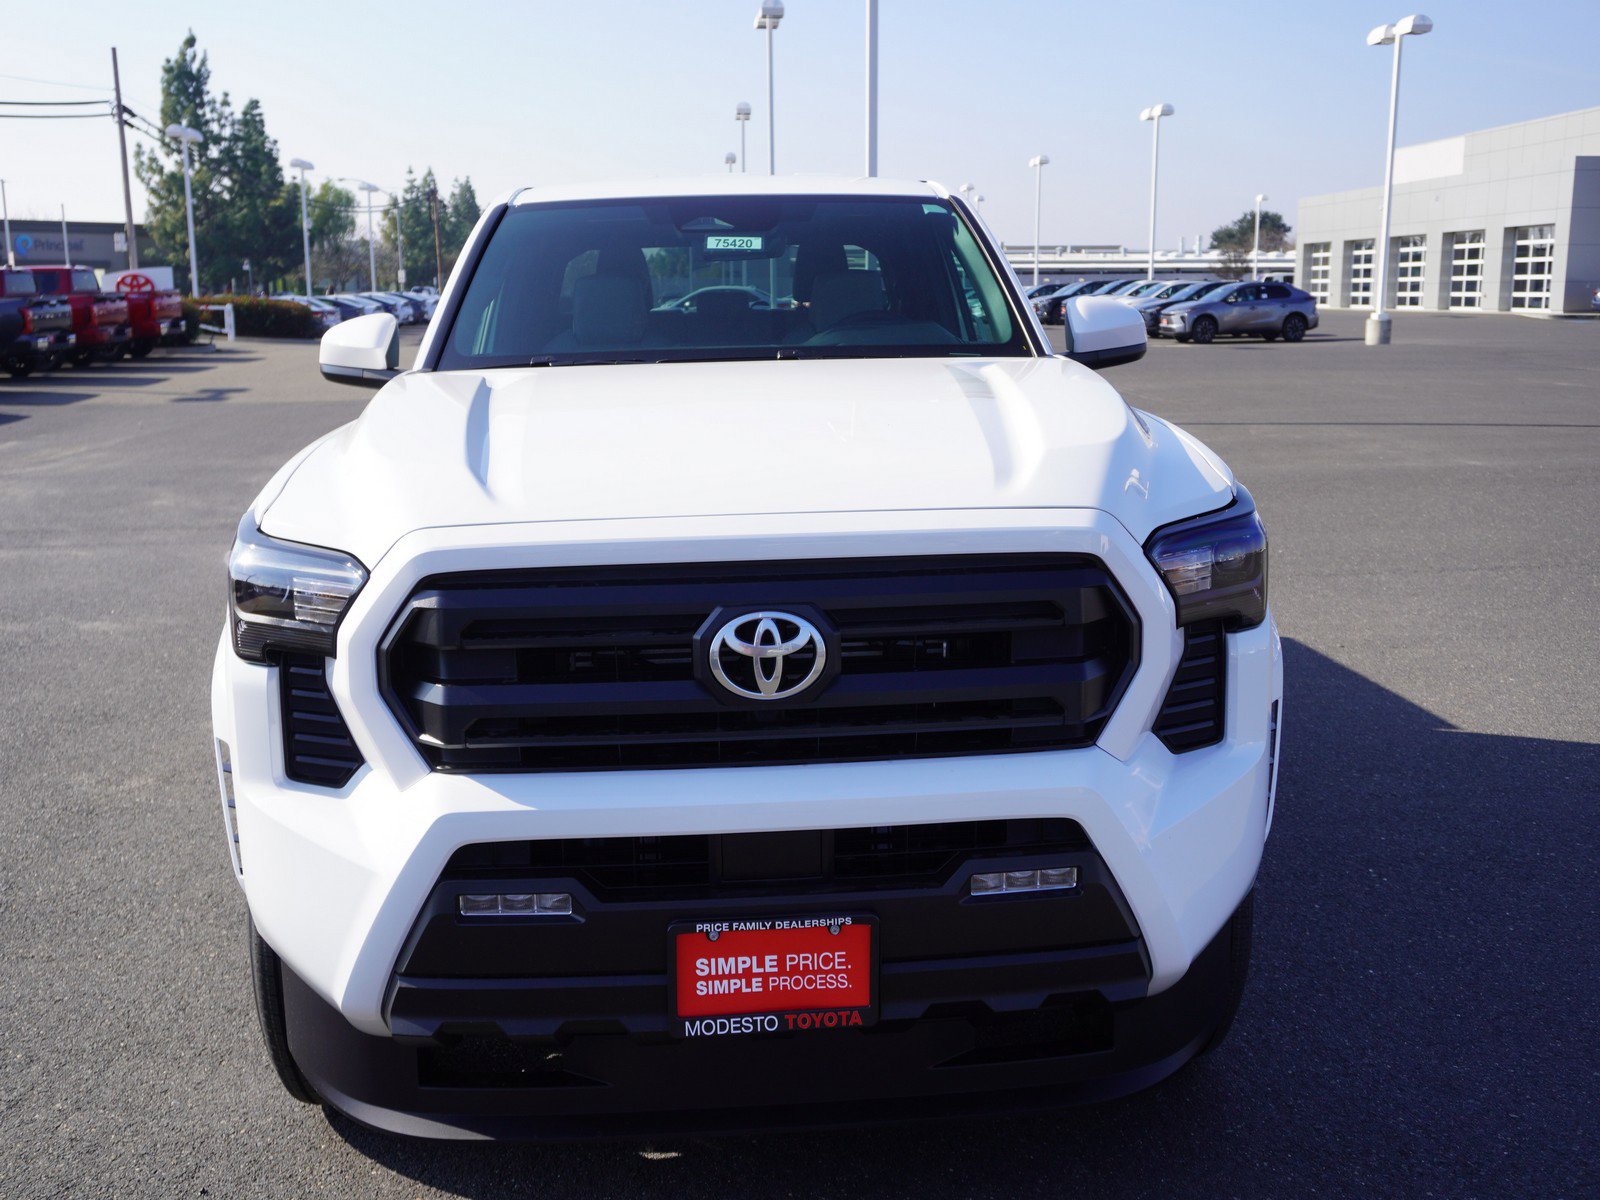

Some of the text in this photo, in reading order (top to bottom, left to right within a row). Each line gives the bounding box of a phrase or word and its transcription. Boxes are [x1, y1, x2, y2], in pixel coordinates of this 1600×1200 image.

[714, 238, 753, 248] 75420
[696, 917, 852, 933] PRICE FAMILY DEALERSHIPS
[695, 951, 852, 977] SIMPLE PRICE.
[696, 974, 852, 996] SIMPLE PROCESS.
[684, 1010, 863, 1037] MODESTO TOYOTA
